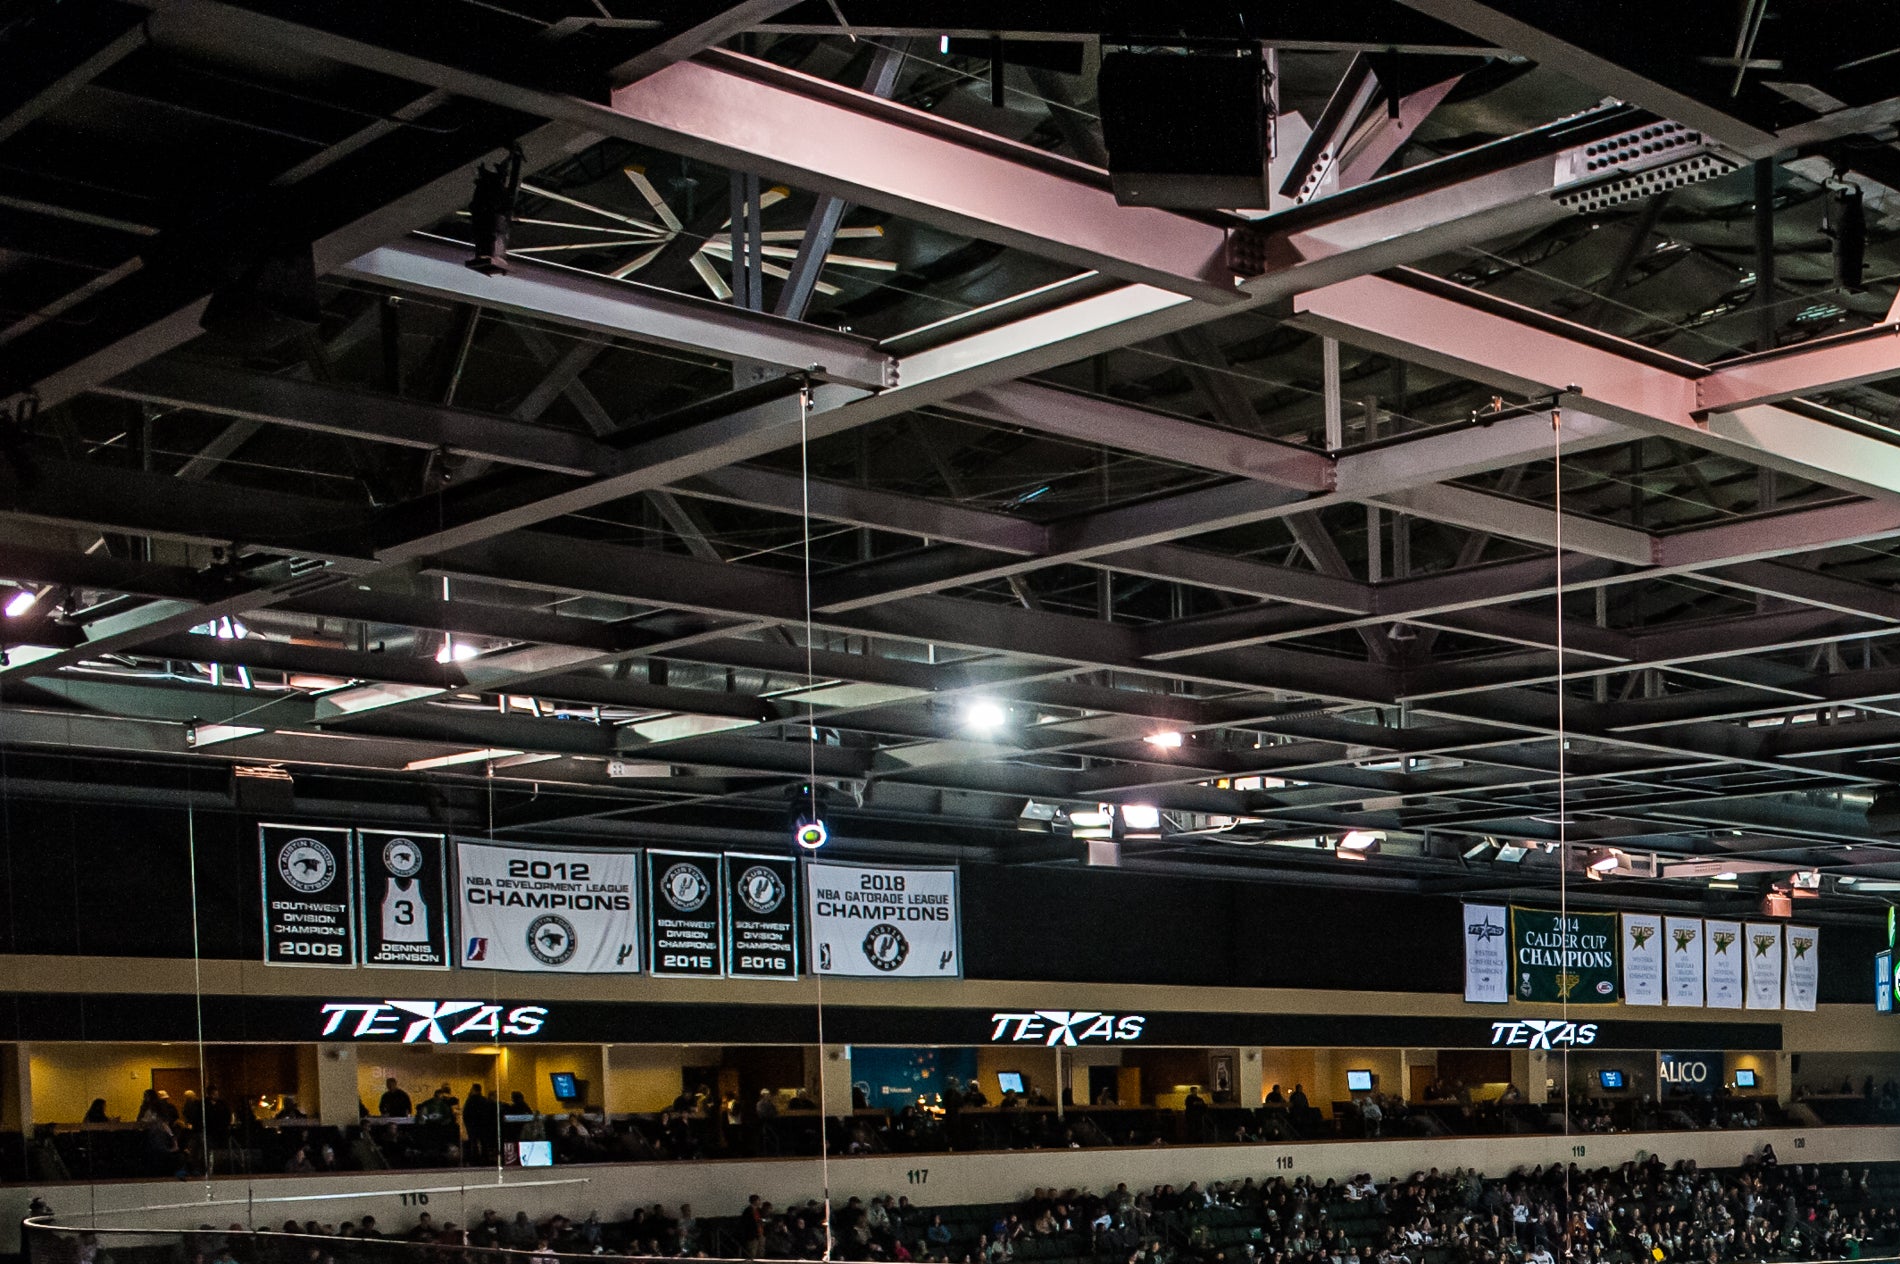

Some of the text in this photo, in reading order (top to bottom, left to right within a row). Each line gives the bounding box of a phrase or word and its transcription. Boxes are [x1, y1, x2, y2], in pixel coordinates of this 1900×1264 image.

[508, 859, 590, 881] 2012
[669, 866, 702, 881] AUSTIN
[746, 870, 776, 883] AUSTIN
[466, 876, 629, 893] NBA DEVELOPMENT LEAGUE
[861, 874, 905, 891] 2018
[467, 888, 631, 911] CHAMPIONS
[817, 889, 949, 905] NBA GATORADE LEAGUE
[272, 901, 346, 913] SOUTHWEST
[394, 900, 415, 925] 3
[817, 902, 949, 921] CHAMPIONS
[283, 913, 336, 924] DIVISION
[658, 919, 717, 930] SOUTHWEST
[735, 921, 791, 931] SOUTHWEST
[1553, 916, 1579, 932] 2014
[273, 924, 346, 936] CHAMPIONS
[666, 930, 709, 940] DIVISION
[743, 932, 783, 941] DIVISION
[869, 926, 903, 941] AUSTIN
[658, 940, 717, 951] CHAMPIONS
[736, 941, 792, 951] CHAMPIONS
[1525, 931, 1607, 949] CALDER CUP
[279, 941, 343, 957] 2008
[381, 943, 432, 953] DENNIS
[373, 952, 440, 963] JOHNSON
[663, 955, 713, 968] 2015
[741, 956, 787, 970] 2016
[1519, 948, 1613, 968] CHAMPIONS
[320, 1000, 549, 1043] TEXAS
[991, 1010, 1146, 1047] TEXAS
[1490, 1020, 1598, 1050] TEXAS
[1572, 1145, 1585, 1157] 119
[1276, 1156, 1294, 1169] 118
[906, 1169, 929, 1184] 117
